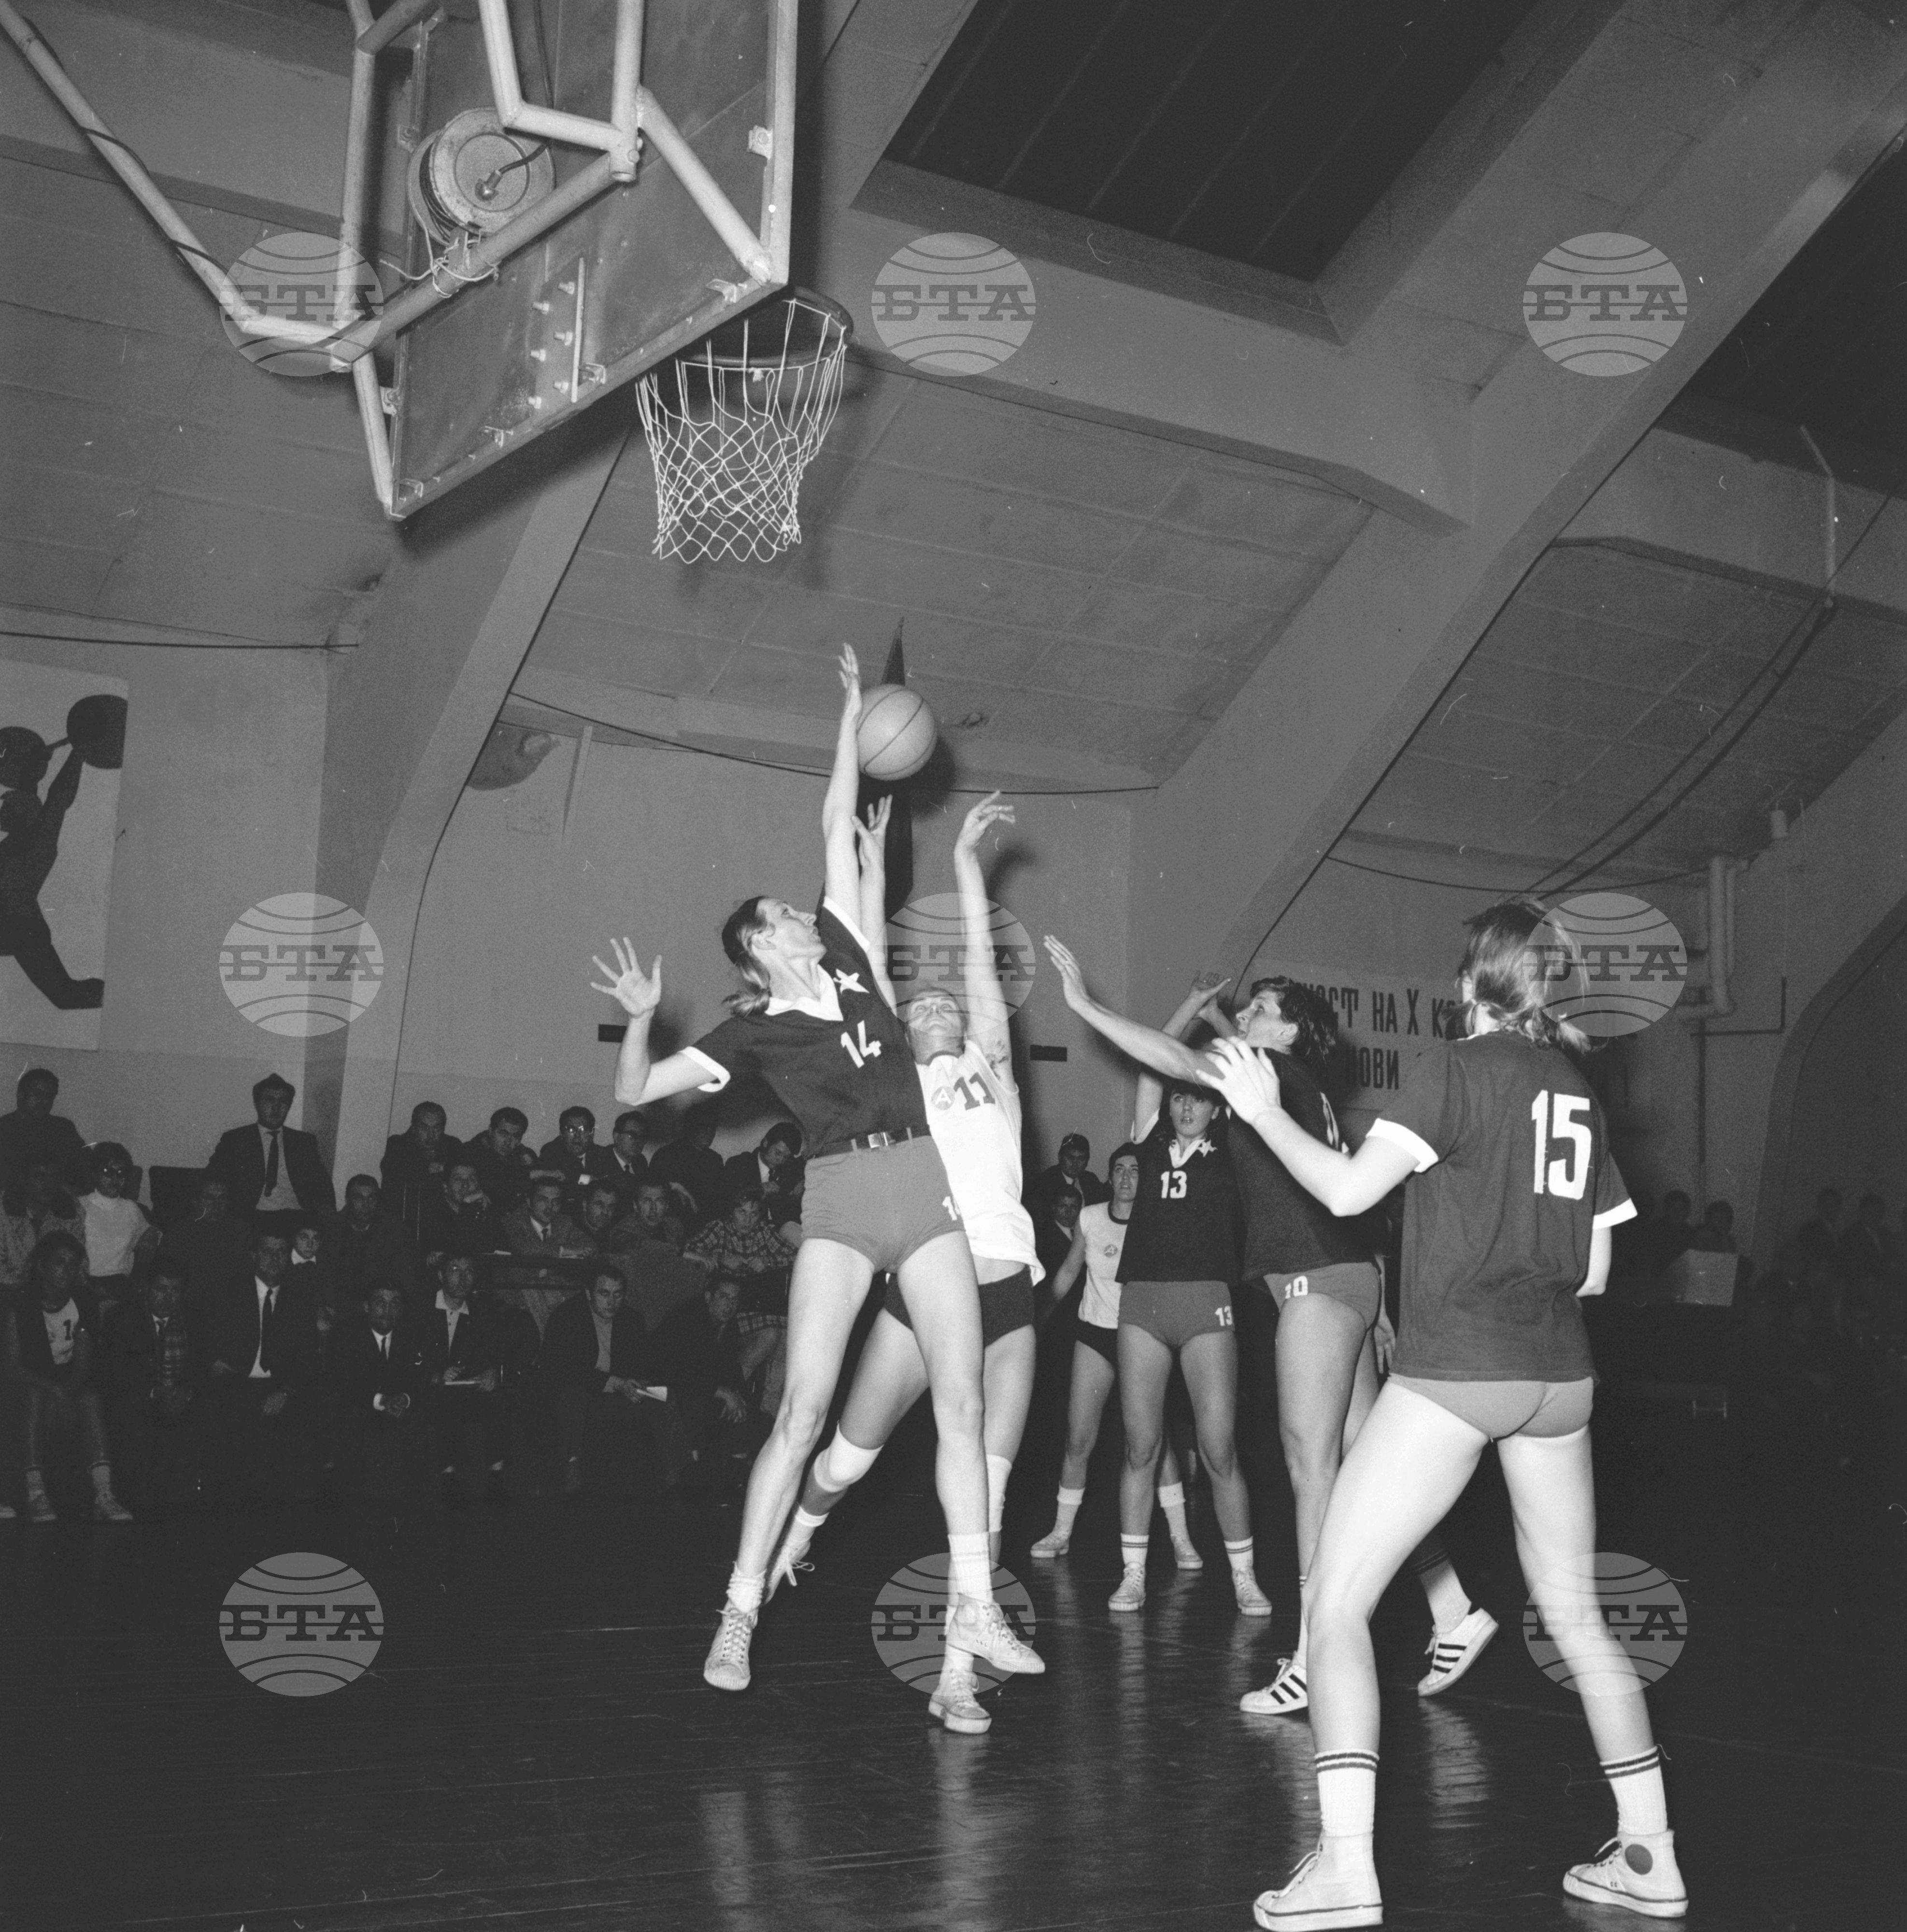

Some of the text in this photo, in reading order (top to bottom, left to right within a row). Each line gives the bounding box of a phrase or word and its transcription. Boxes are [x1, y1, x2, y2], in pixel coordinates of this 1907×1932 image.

[1372, 991, 1397, 1034] НА
[840, 1020, 882, 1068] 14
[954, 1072, 996, 1110] 11
[1532, 1090, 1592, 1200] 15
[1161, 1170, 1187, 1199] 13
[1285, 1275, 1309, 1299] 10
[1214, 1305, 1233, 1326] 13
